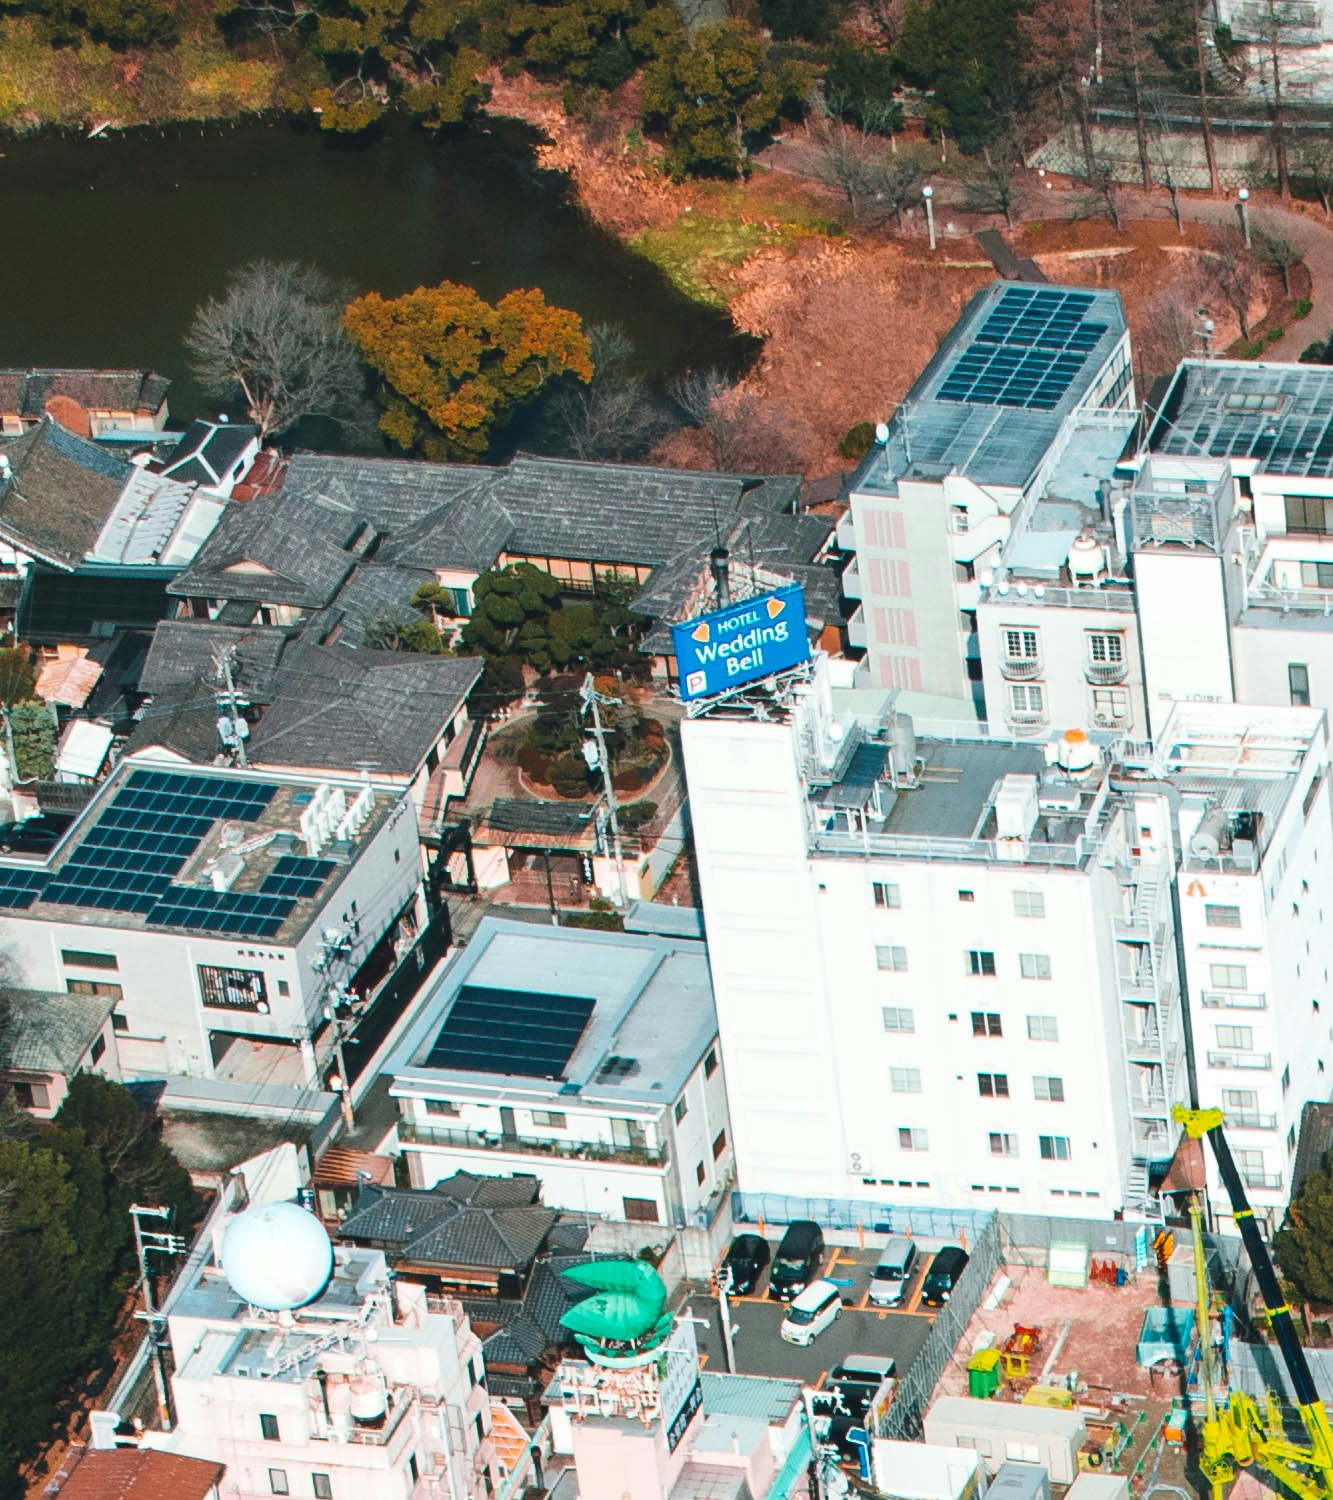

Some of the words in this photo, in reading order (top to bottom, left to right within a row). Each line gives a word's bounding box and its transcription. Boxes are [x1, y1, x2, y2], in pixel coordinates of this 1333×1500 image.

[717, 610, 762, 634] HOTEL
[694, 619, 789, 664] Wedding
[726, 649, 764, 677] Bell
[689, 674, 703, 691] P
